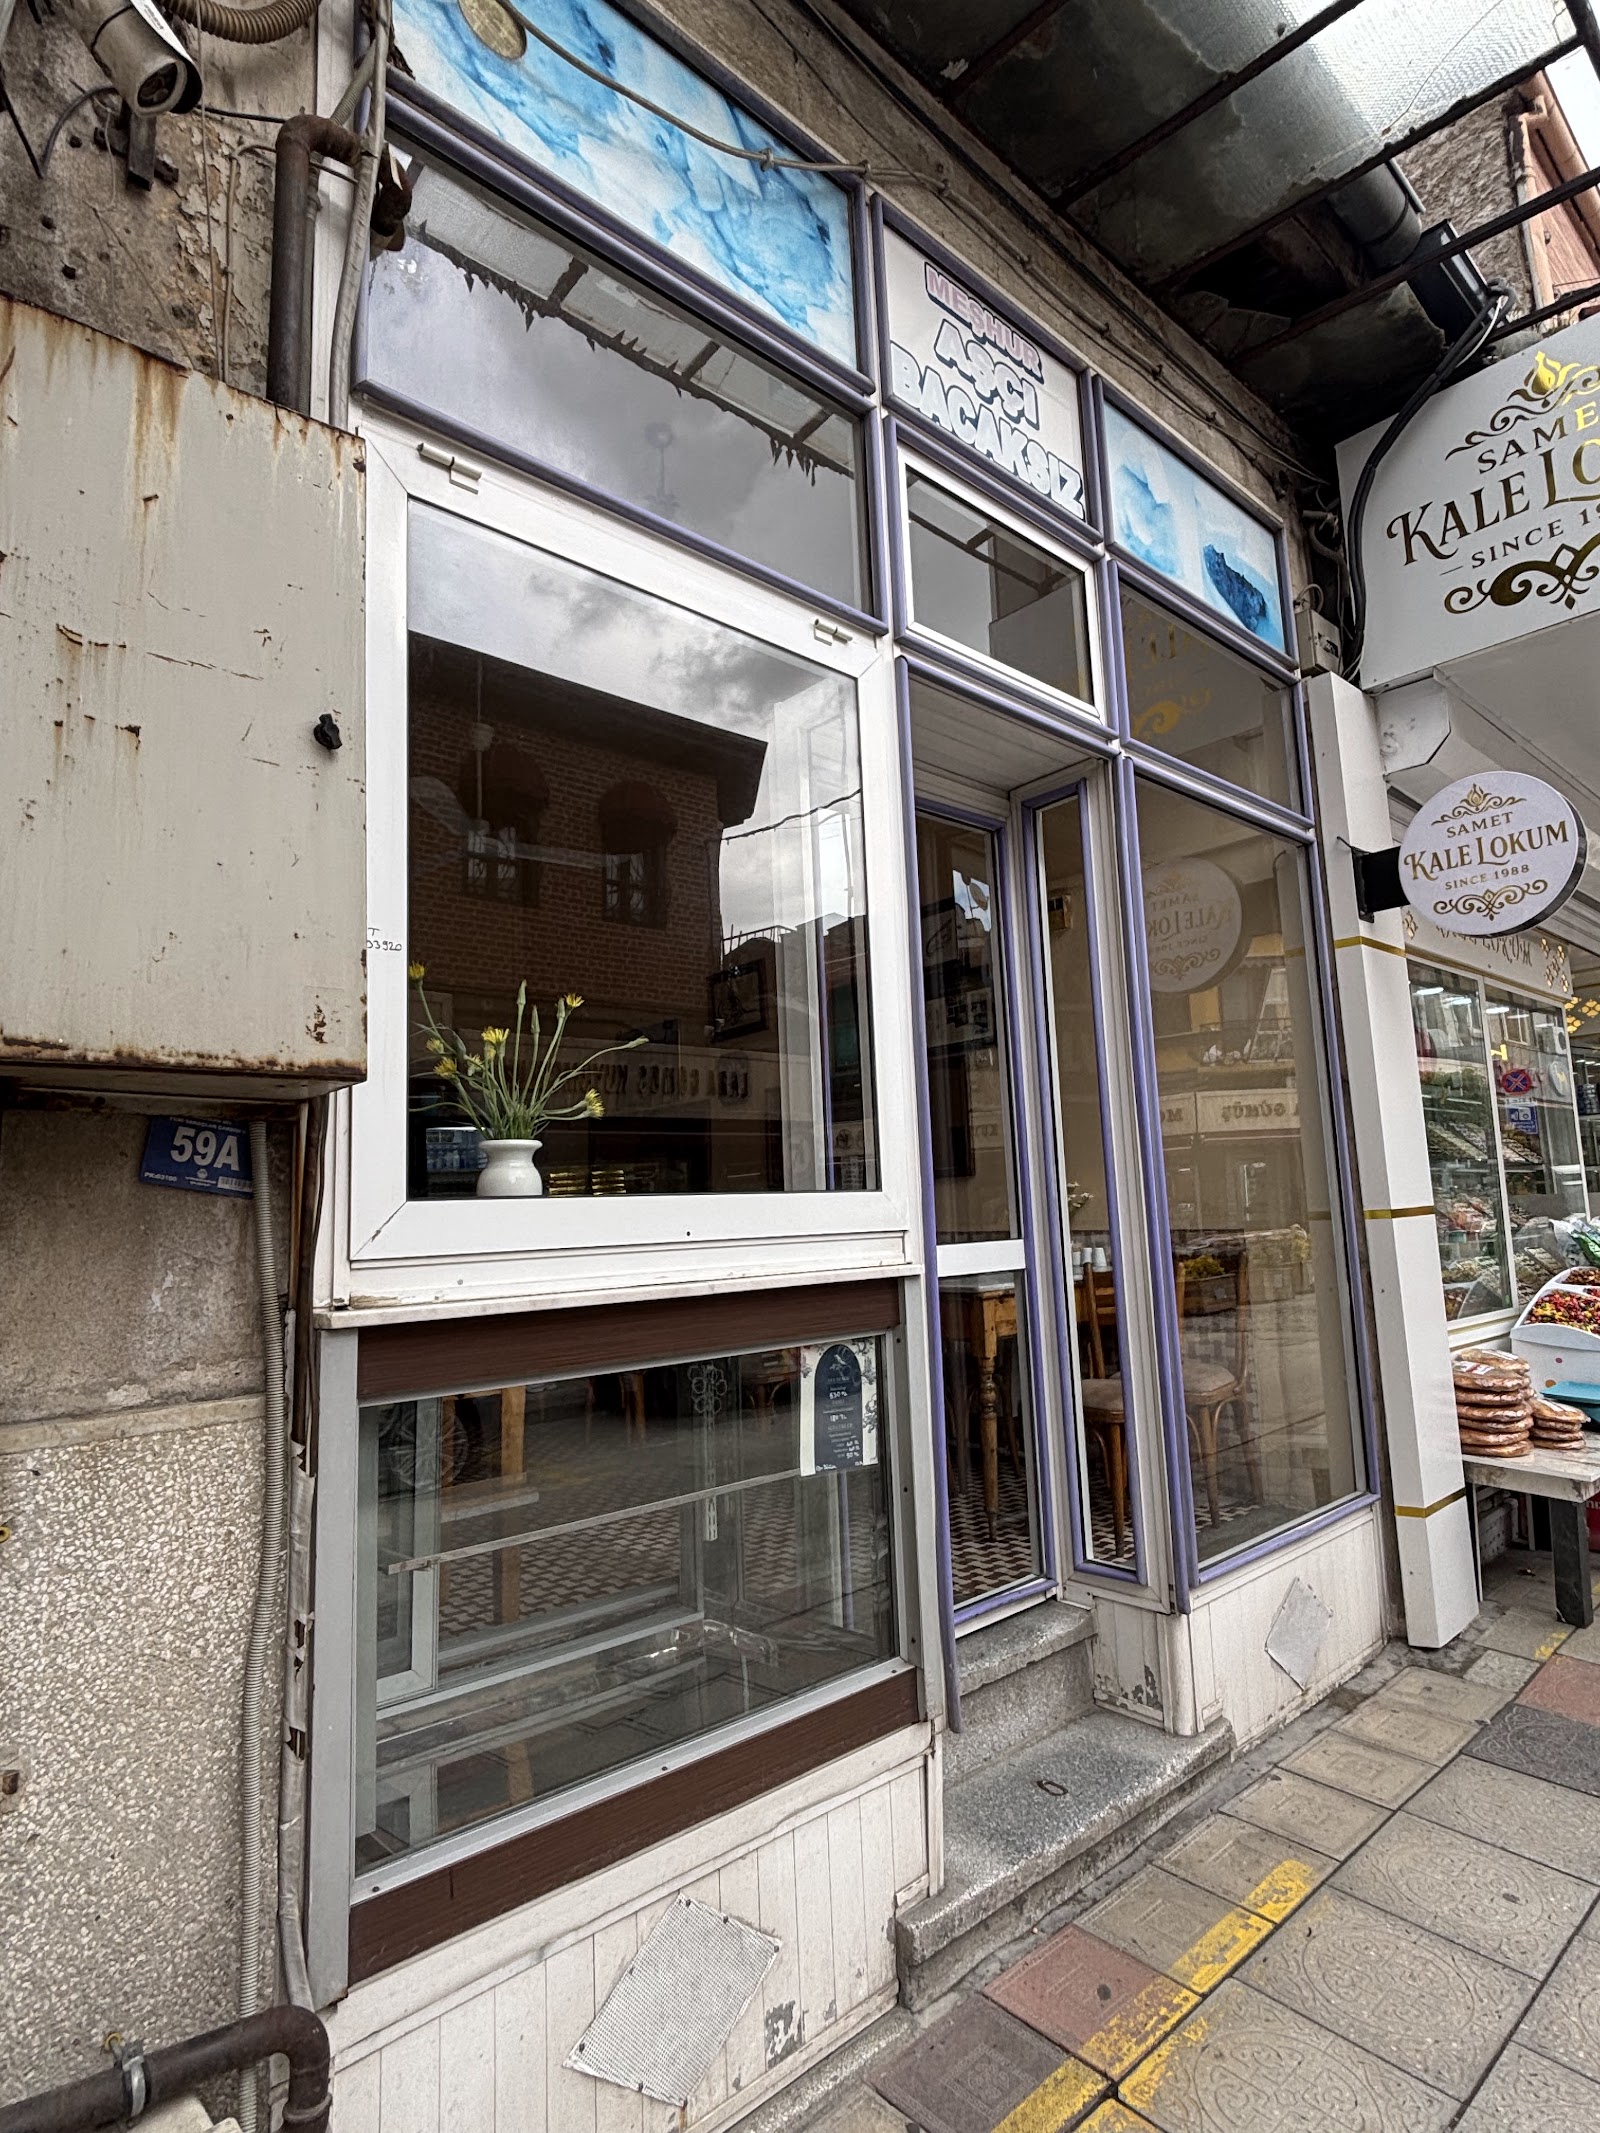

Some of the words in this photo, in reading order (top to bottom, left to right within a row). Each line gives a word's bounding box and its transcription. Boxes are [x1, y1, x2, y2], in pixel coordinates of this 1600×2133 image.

[925, 262, 1044, 384] MEŞHUR
[890, 340, 1085, 520] BACAKSIZ
[1386, 471, 1530, 566] KALE
[1471, 519, 1564, 569] SINCE
[1403, 844, 1472, 881] KALE
[1475, 820, 1568, 866] LOKUM
[1446, 811, 1513, 838] SAMET
[1445, 873, 1488, 890] SINCE
[1494, 864, 1530, 879] 1988
[170, 1126, 240, 1171] 59A
